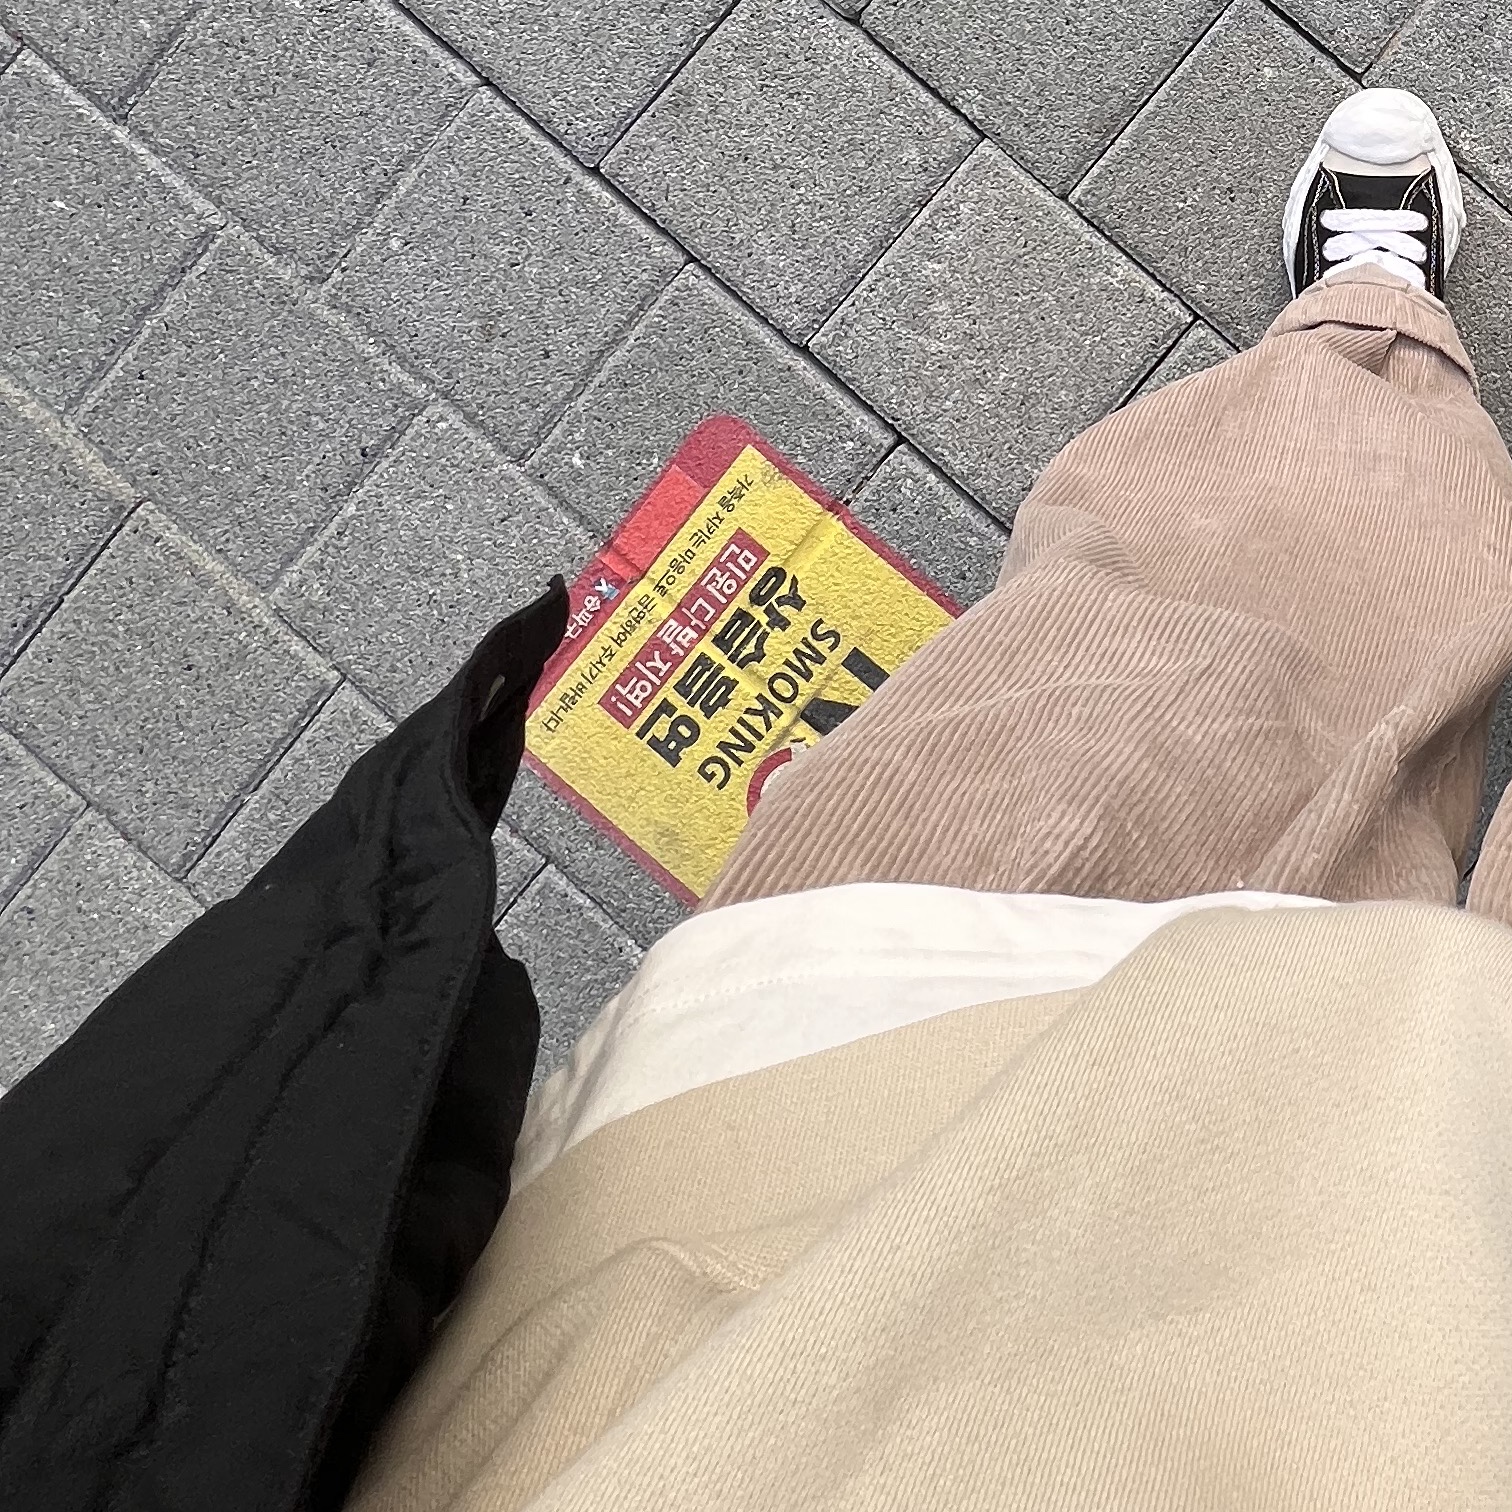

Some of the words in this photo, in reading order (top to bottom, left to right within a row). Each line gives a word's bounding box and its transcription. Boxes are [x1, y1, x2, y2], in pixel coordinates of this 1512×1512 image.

[715, 473, 755, 513] 가족을
[687, 510, 726, 550] 지키는
[651, 548, 697, 598] 마음으로
[698, 542, 758, 604] 민원
[607, 593, 658, 649] 금연하여
[654, 596, 716, 657] 다발
[580, 644, 618, 685] 주시기
[609, 650, 673, 717] 지역!
[634, 564, 807, 769] 상습흡연
[695, 617, 841, 791] SMOKING
